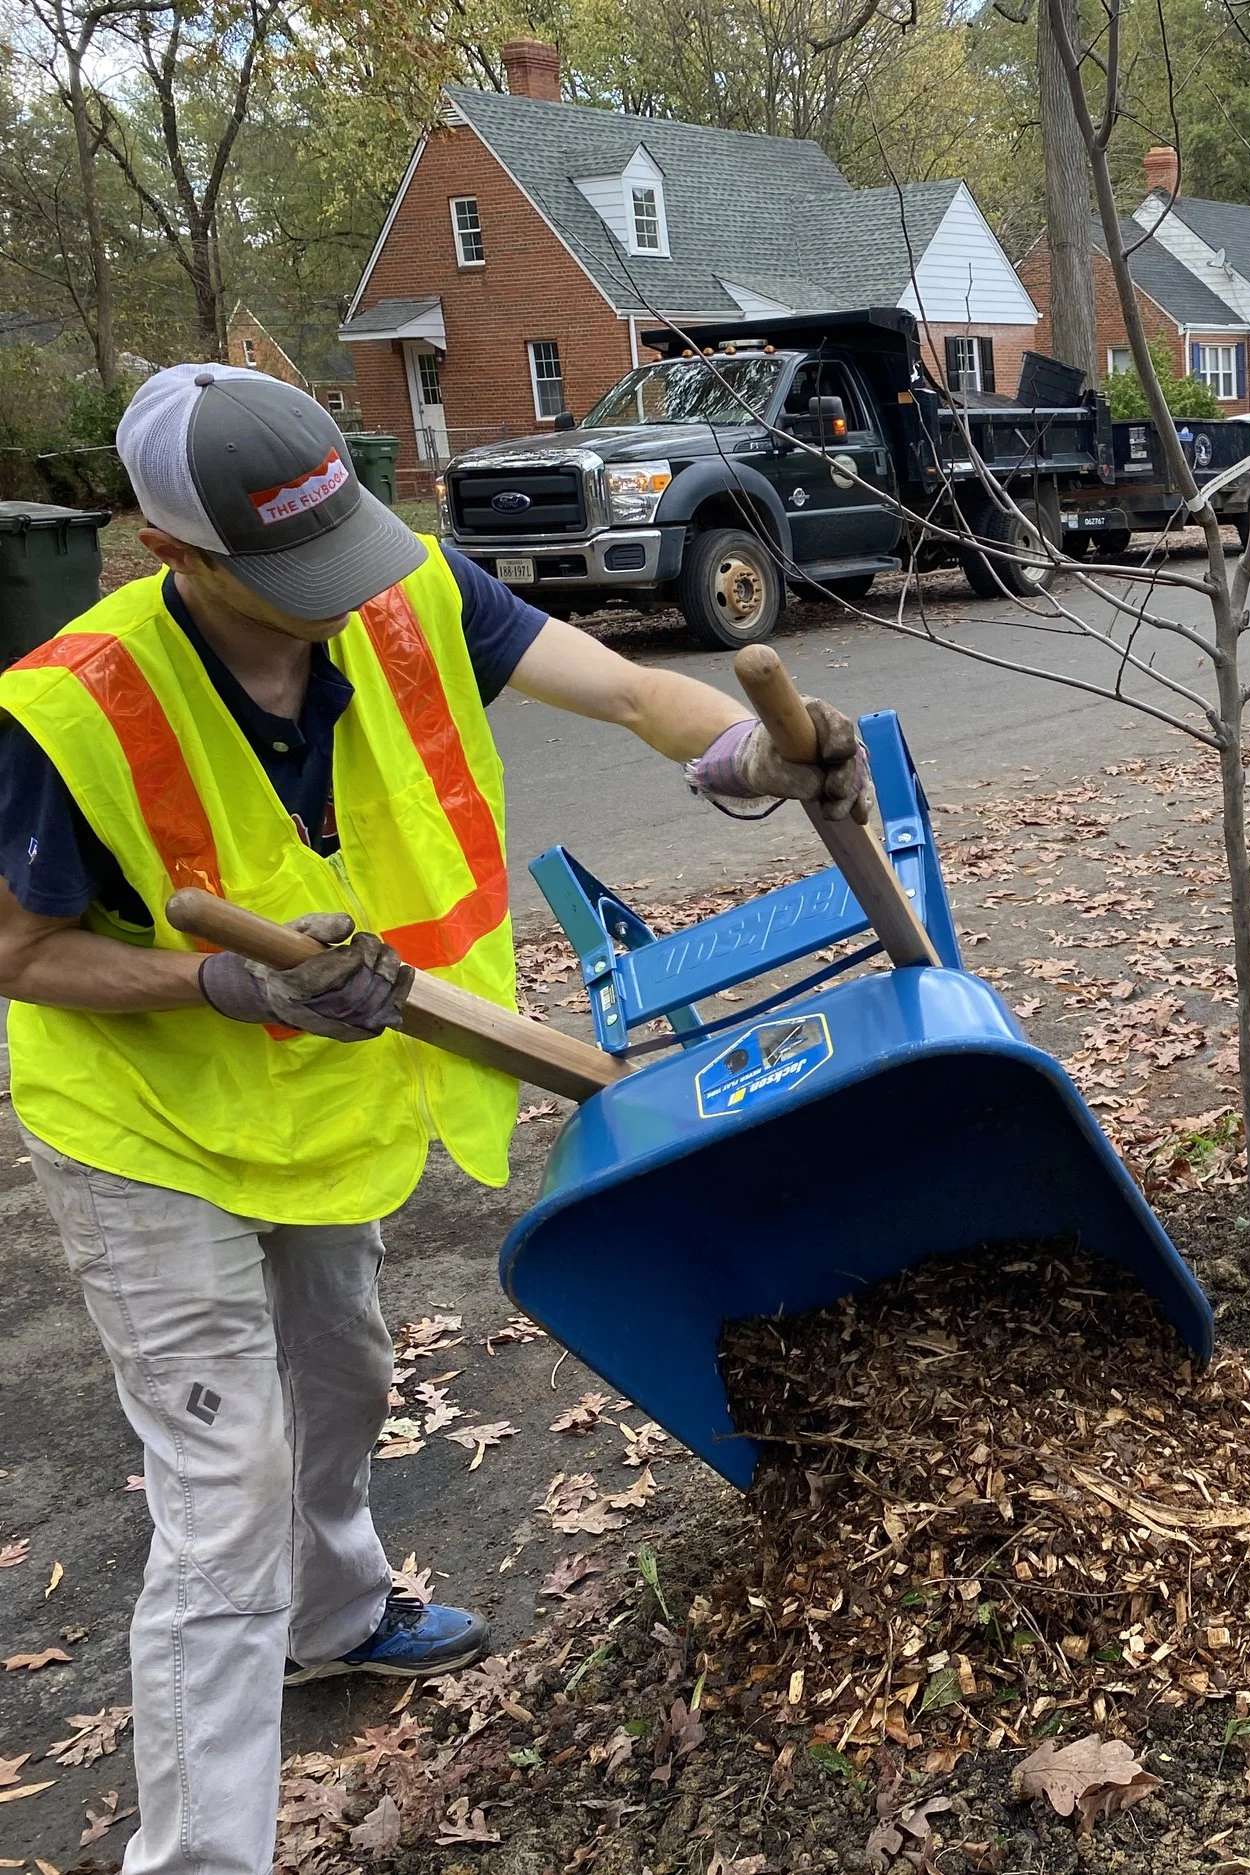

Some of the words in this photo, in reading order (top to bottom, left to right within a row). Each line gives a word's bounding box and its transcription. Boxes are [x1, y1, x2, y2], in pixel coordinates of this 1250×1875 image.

[266, 500, 299, 519] THE
[300, 470, 345, 508] FLYBOOK
[721, 1077, 739, 1093] FLAT
[740, 1068, 762, 1083] NEVER
[749, 1058, 807, 1093] Jackson
